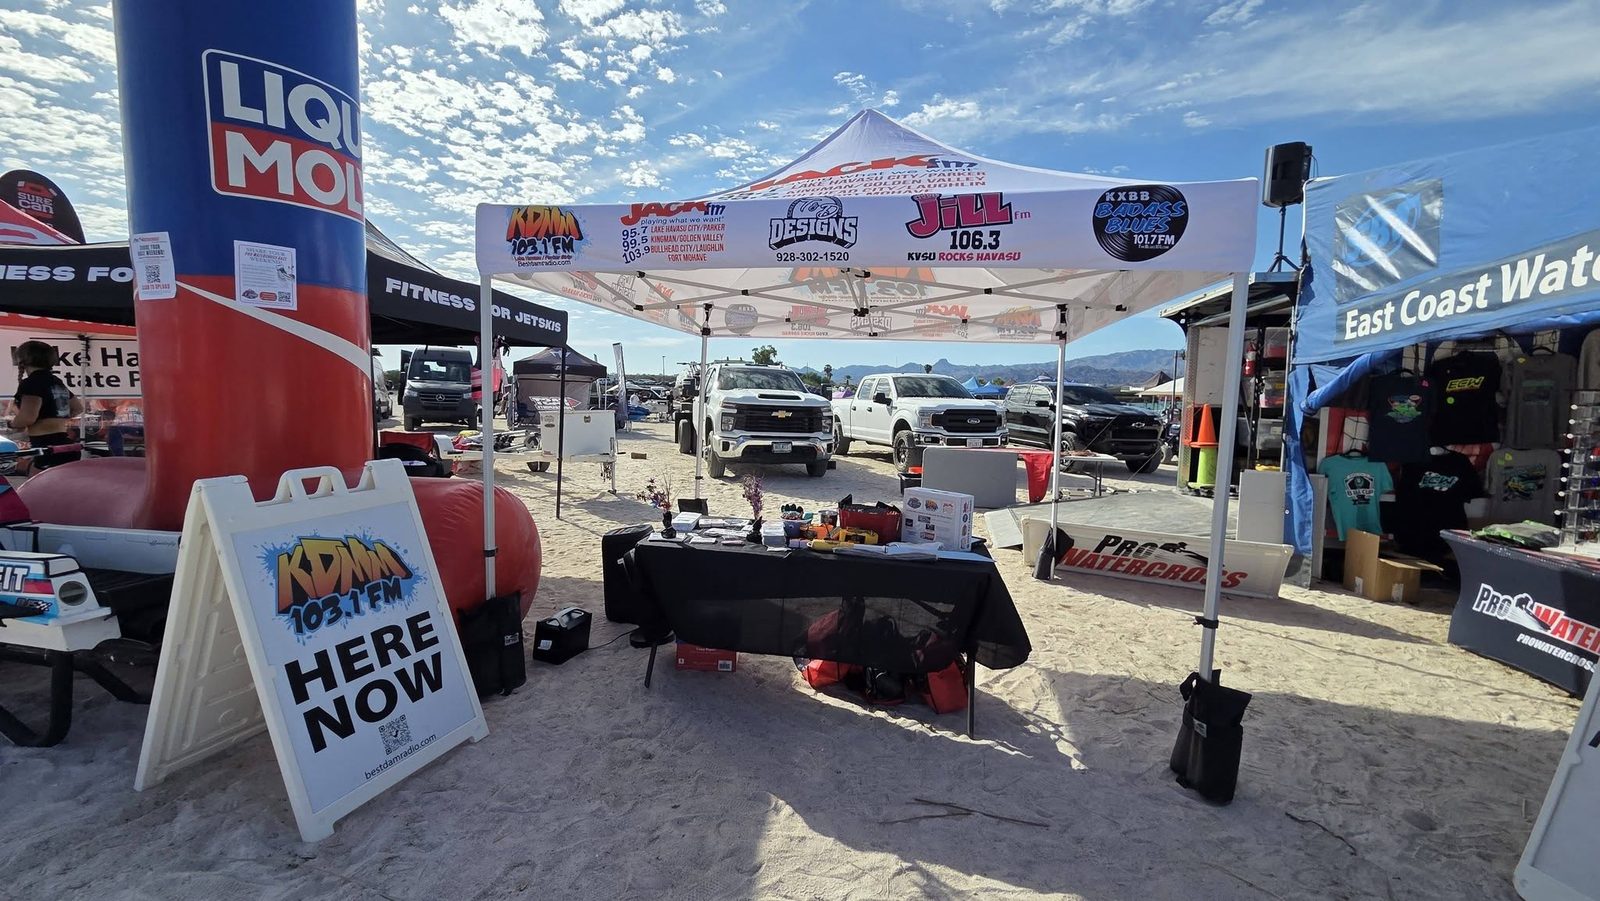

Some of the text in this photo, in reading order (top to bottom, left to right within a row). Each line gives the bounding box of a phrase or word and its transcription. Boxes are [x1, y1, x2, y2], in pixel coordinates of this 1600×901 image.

[220, 60, 362, 158] LIQU
[225, 130, 363, 214] MOL
[17, 191, 53, 206] SURE
[1105, 191, 1150, 201] KXBB
[620, 200, 726, 226] JACK fm
[1014, 211, 1031, 220] fm
[1095, 201, 1186, 218] BADASS
[506, 205, 584, 242] KDMM
[622, 223, 726, 241] 95.7 LAKE HAVASU CITY/PARKER
[640, 218, 667, 227] playing
[668, 217, 687, 225] what
[1104, 217, 1172, 234] BLUES
[622, 233, 724, 252] 99.5 KINGMAN/GOLDEN VALLEY
[769, 216, 859, 250] DESIGNS
[950, 230, 1001, 250] 106.3
[1133, 234, 1175, 245] 101.7 FM
[511, 237, 575, 255] 103.1 FM
[622, 243, 724, 264] 103.9 BULLHEAD CITY/LAUGHLIN
[907, 251, 1022, 261] KVSU ROCKS HAVASU
[668, 253, 708, 262] FORT MOHAVE
[776, 252, 850, 262] 928-302-1520
[385, 277, 562, 333] FITNESS OR JETSKIS
[1343, 301, 1395, 340] East
[1400, 273, 1492, 326] Coast
[1446, 376, 1485, 392] ECW
[1094, 534, 1158, 558] PRO
[276, 535, 413, 615] KDMM
[290, 577, 403, 635] 103.1 FM
[1473, 584, 1513, 620] PRO
[284, 611, 440, 706] HERE
[303, 651, 444, 754] NOW
[364, 733, 437, 781] bestdamradio.com
